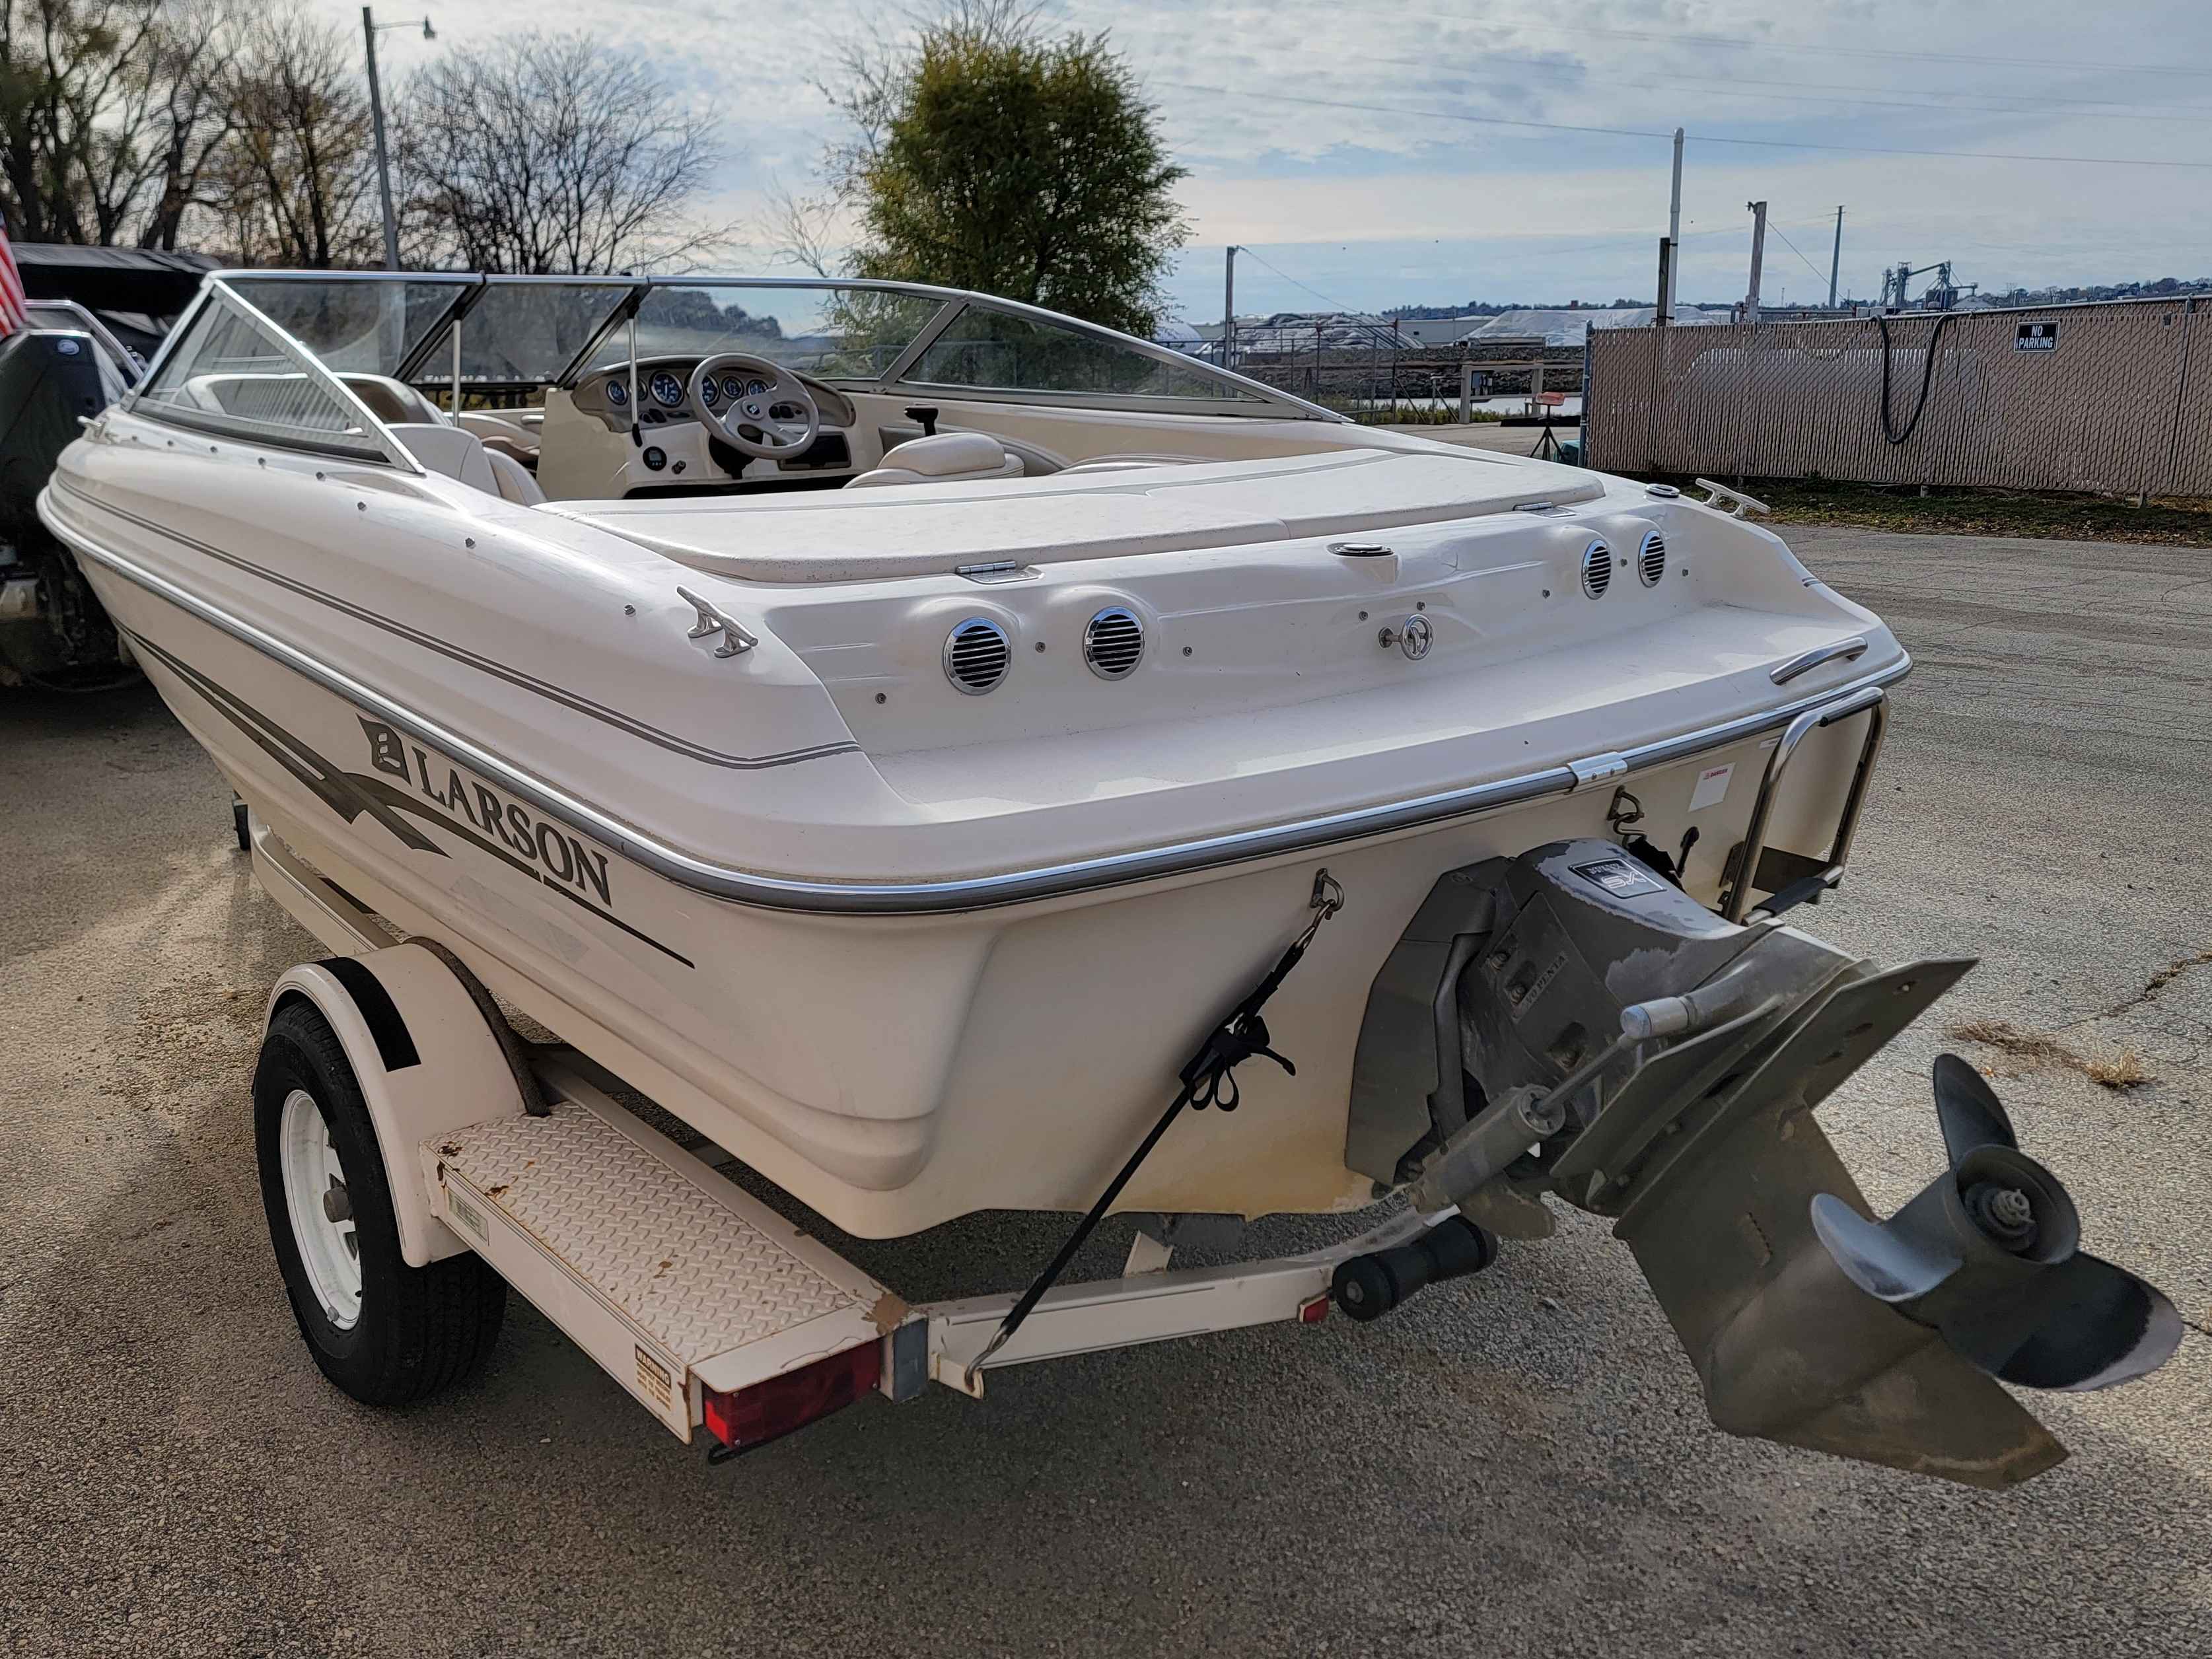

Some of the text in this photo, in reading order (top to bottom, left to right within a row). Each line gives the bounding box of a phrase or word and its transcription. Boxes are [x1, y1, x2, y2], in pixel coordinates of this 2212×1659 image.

[2031, 325, 2044, 337] NO
[2018, 336, 2053, 349] PARKING
[411, 746, 613, 908] LARSON
[1601, 871, 1647, 889] SX
[637, 1347, 670, 1385] WARNING
